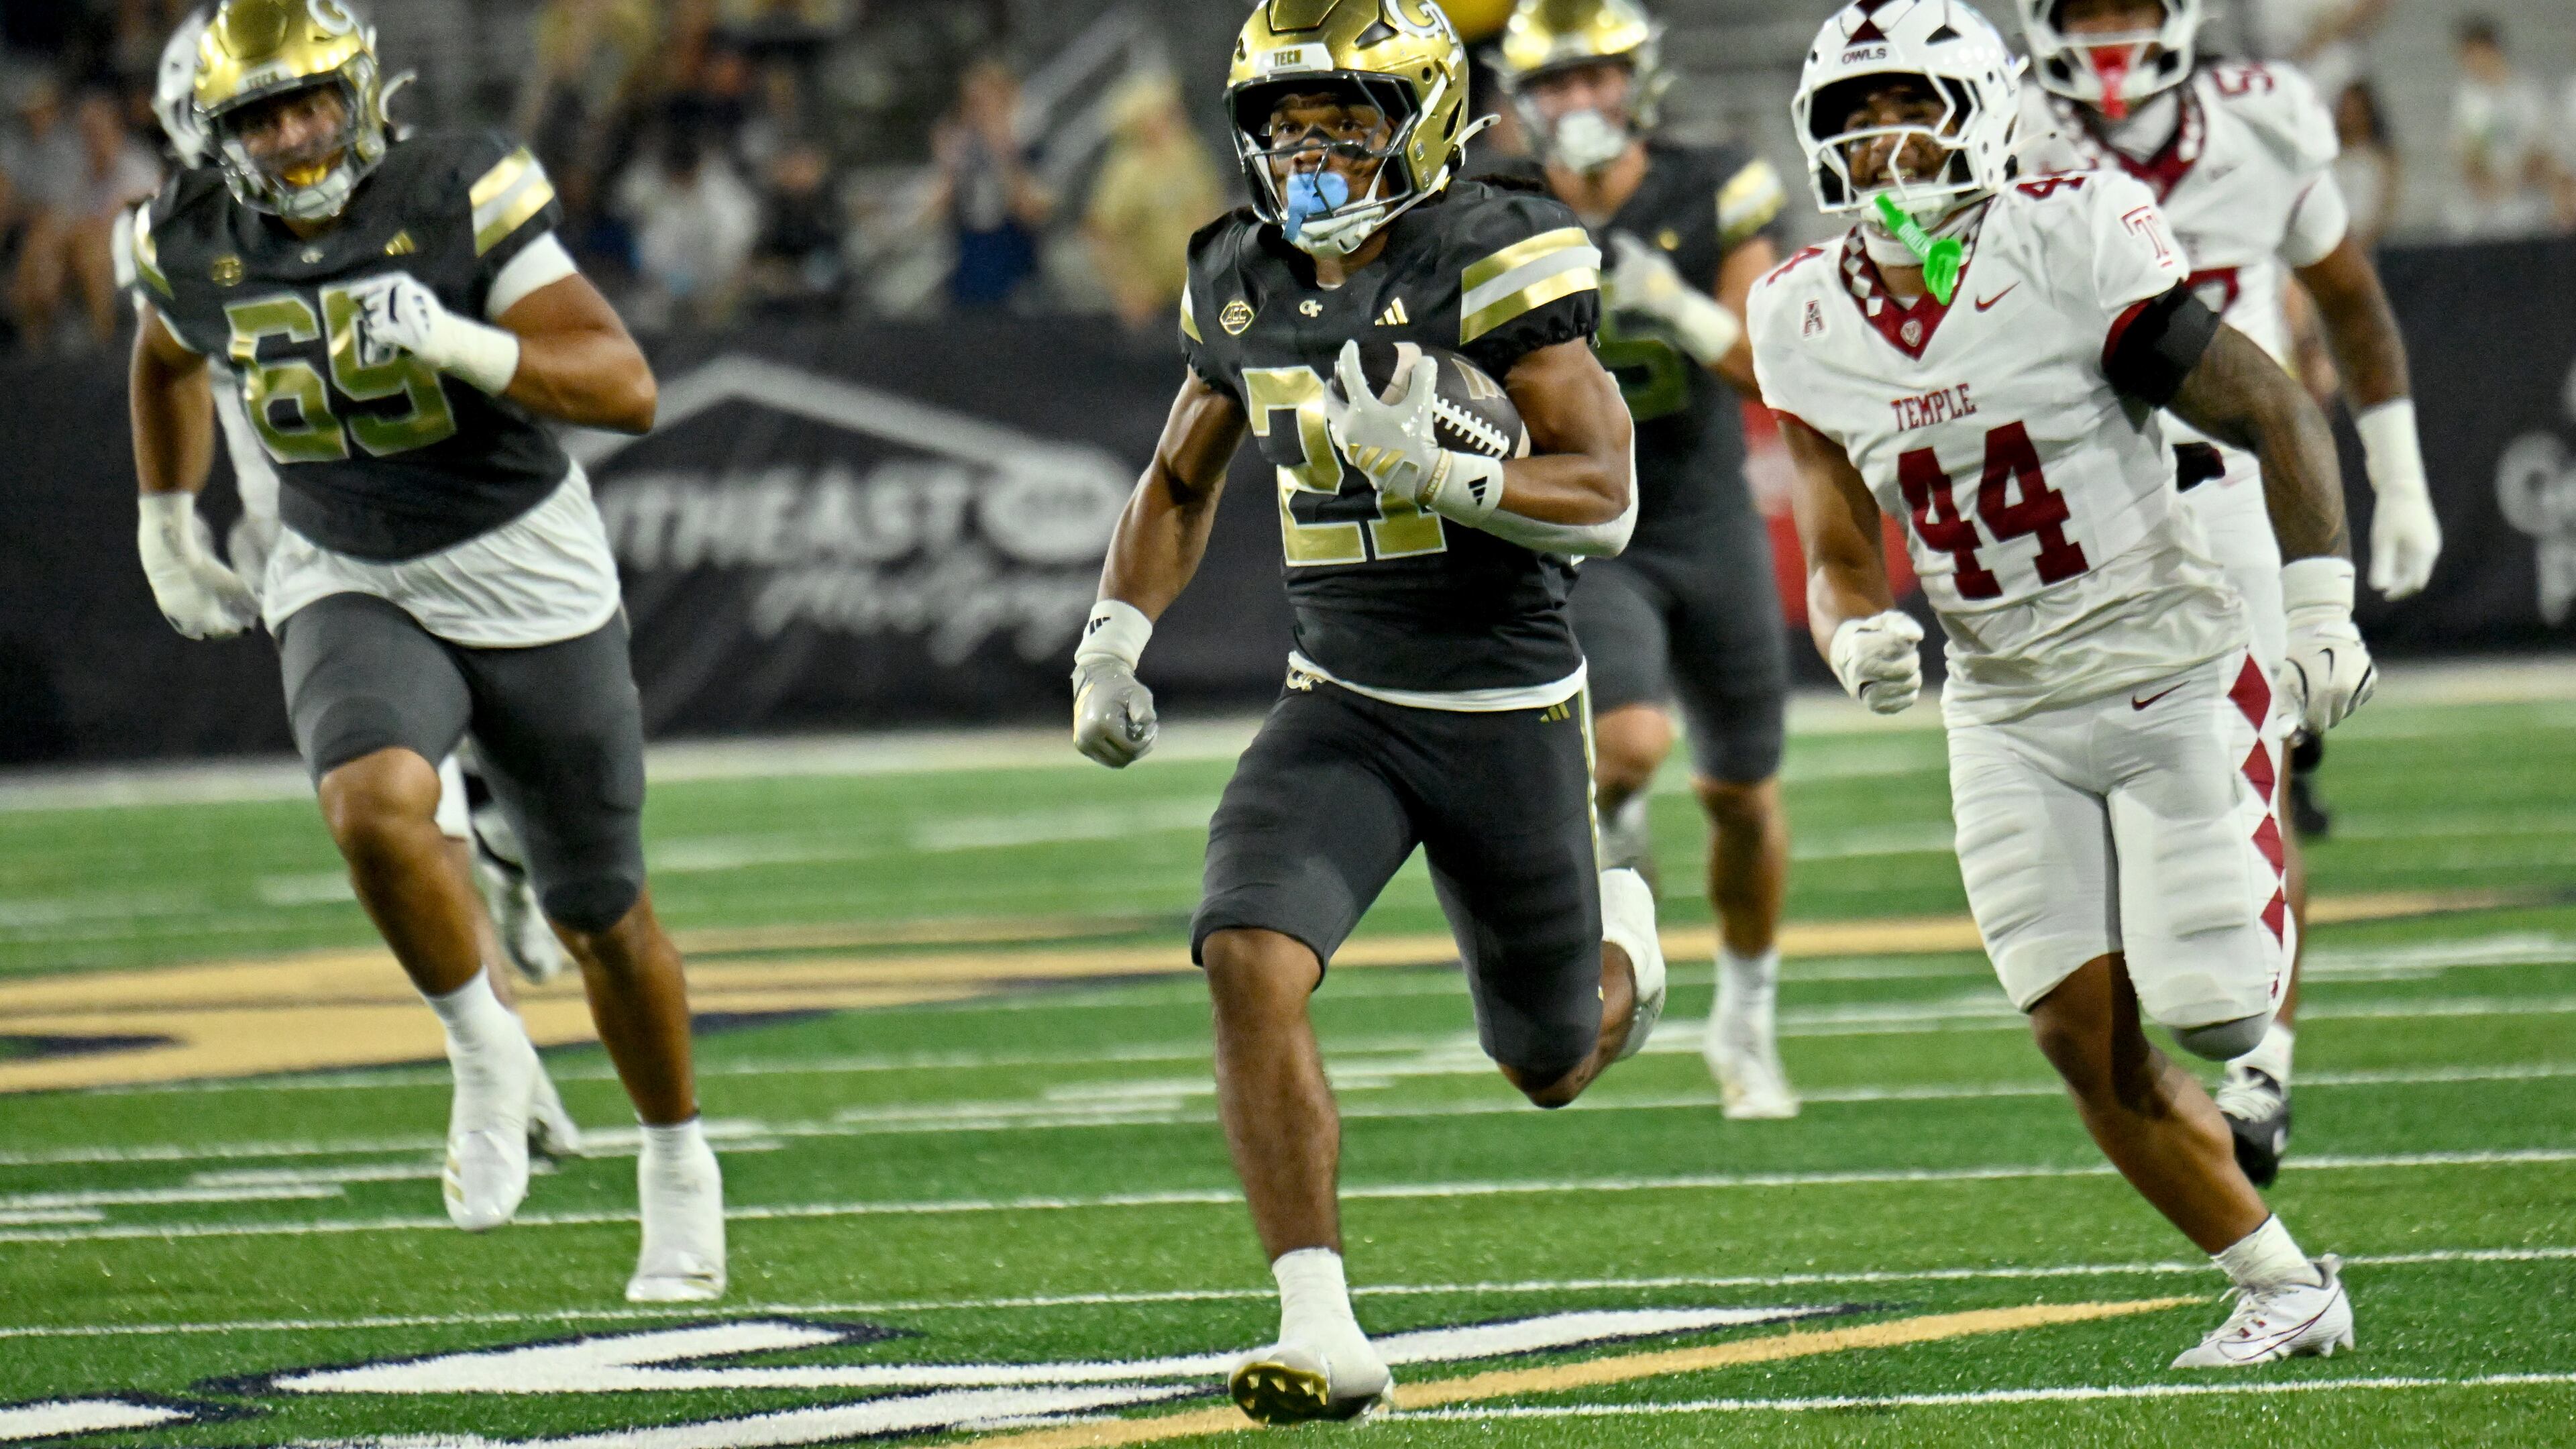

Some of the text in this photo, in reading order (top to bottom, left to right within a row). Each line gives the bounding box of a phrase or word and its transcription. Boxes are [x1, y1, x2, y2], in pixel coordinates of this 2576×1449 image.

[1273, 49, 1302, 66] TECH
[1841, 48, 1887, 64] OWLS
[1224, 306, 1248, 323] ACC
[223, 284, 458, 464] 69
[1890, 383, 1977, 431] TEMPLE
[1897, 420, 2090, 600] 44
